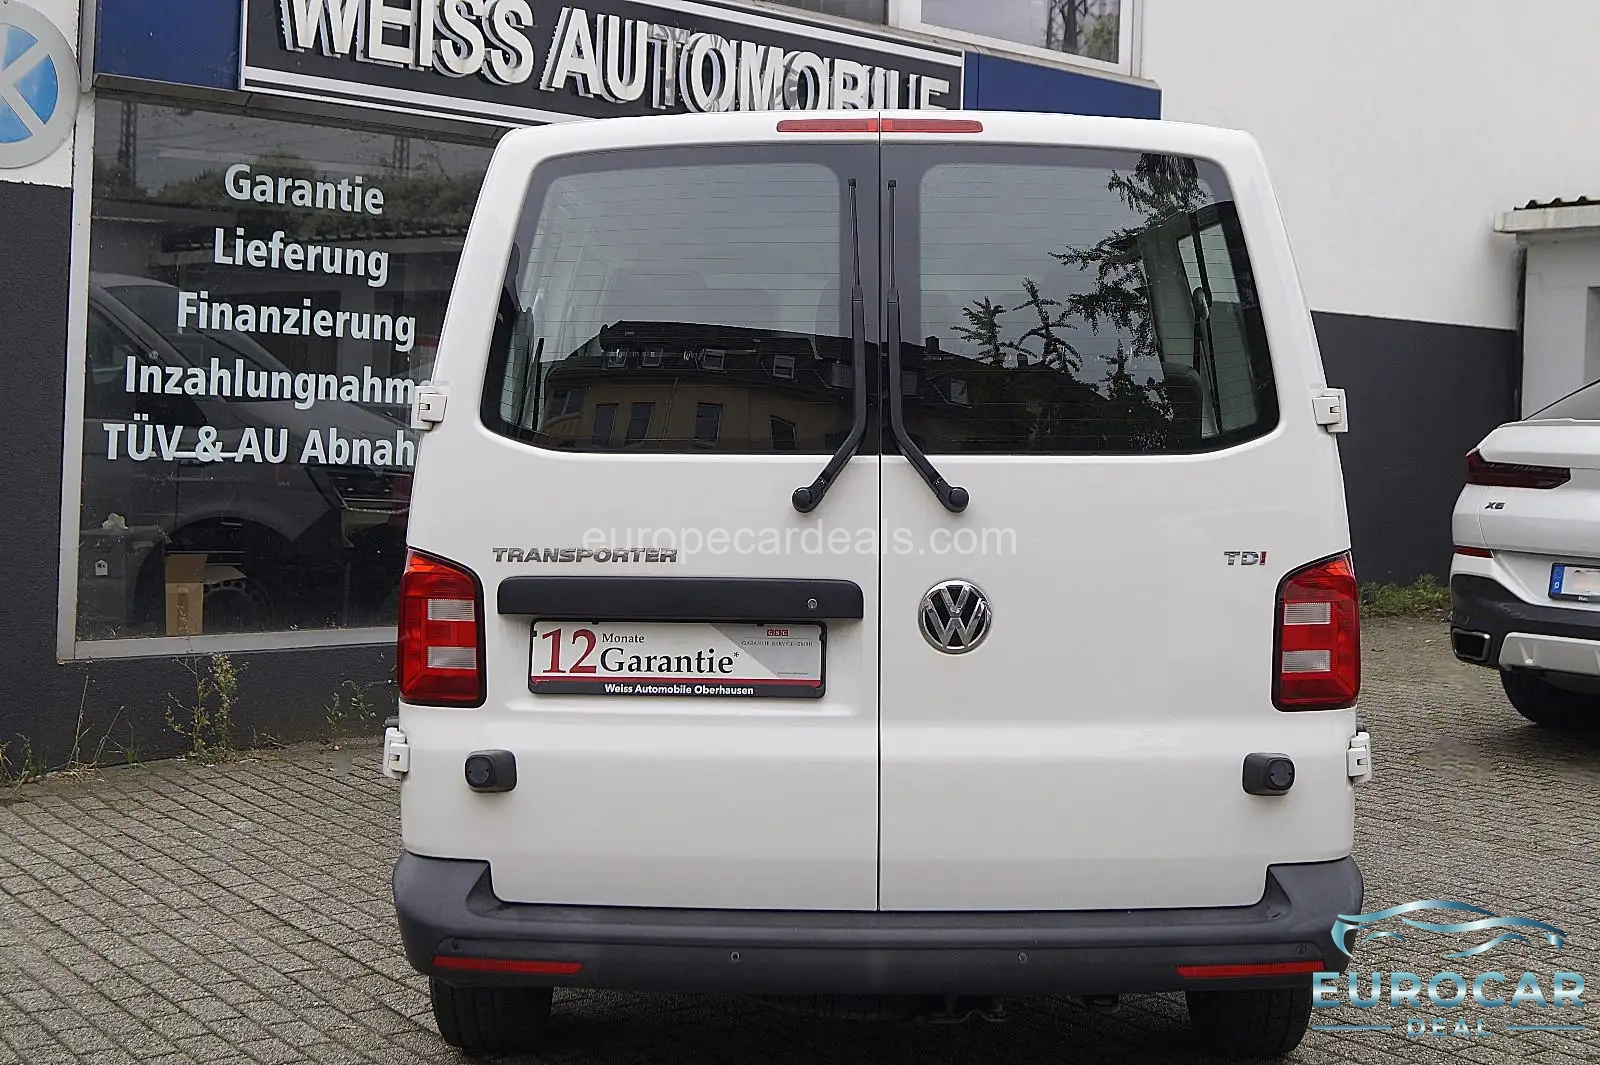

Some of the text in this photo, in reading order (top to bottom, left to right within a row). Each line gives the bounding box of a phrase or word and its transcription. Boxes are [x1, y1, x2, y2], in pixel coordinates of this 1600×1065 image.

[276, 0, 535, 85] WEISS
[224, 163, 384, 215] Garantie
[214, 227, 389, 288] Lieferung
[177, 290, 416, 352] Finanzierung
[103, 413, 183, 462] TÜV
[194, 425, 223, 462] &
[234, 427, 288, 464] AU
[1484, 501, 1506, 510] X6
[493, 547, 678, 563] TRANSPORTER
[1223, 551, 1267, 566] TDI
[542, 628, 645, 673] 12 Monate
[604, 683, 754, 695] Weiss Automobile Oberhausen
